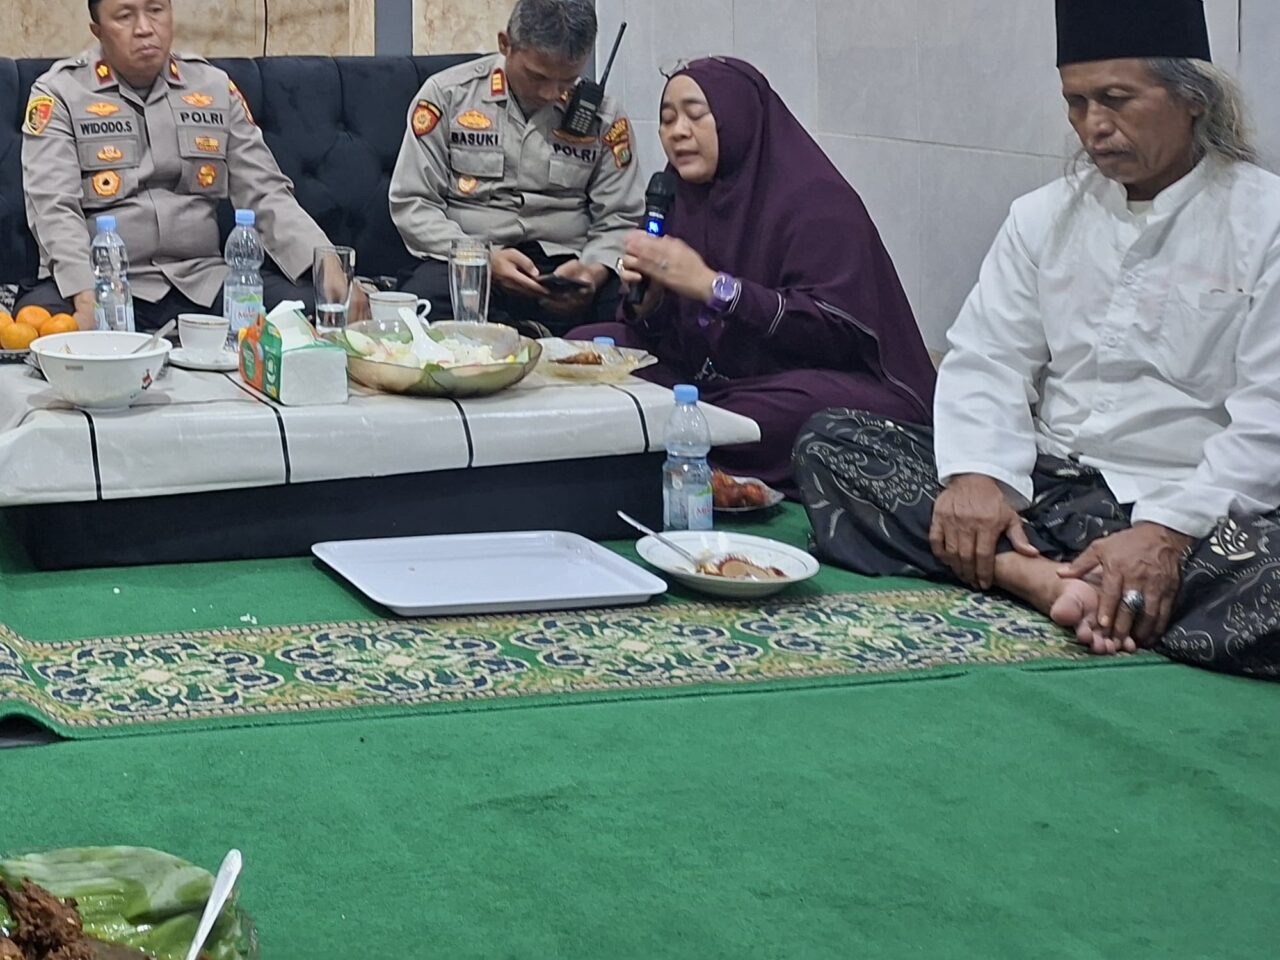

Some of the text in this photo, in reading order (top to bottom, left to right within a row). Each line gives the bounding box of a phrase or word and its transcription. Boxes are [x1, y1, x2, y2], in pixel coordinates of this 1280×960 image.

[180, 111, 224, 126] POLRI
[79, 120, 133, 135] WIDODO.S
[451, 131, 499, 146] BASUKI
[553, 143, 596, 163] POLRI
